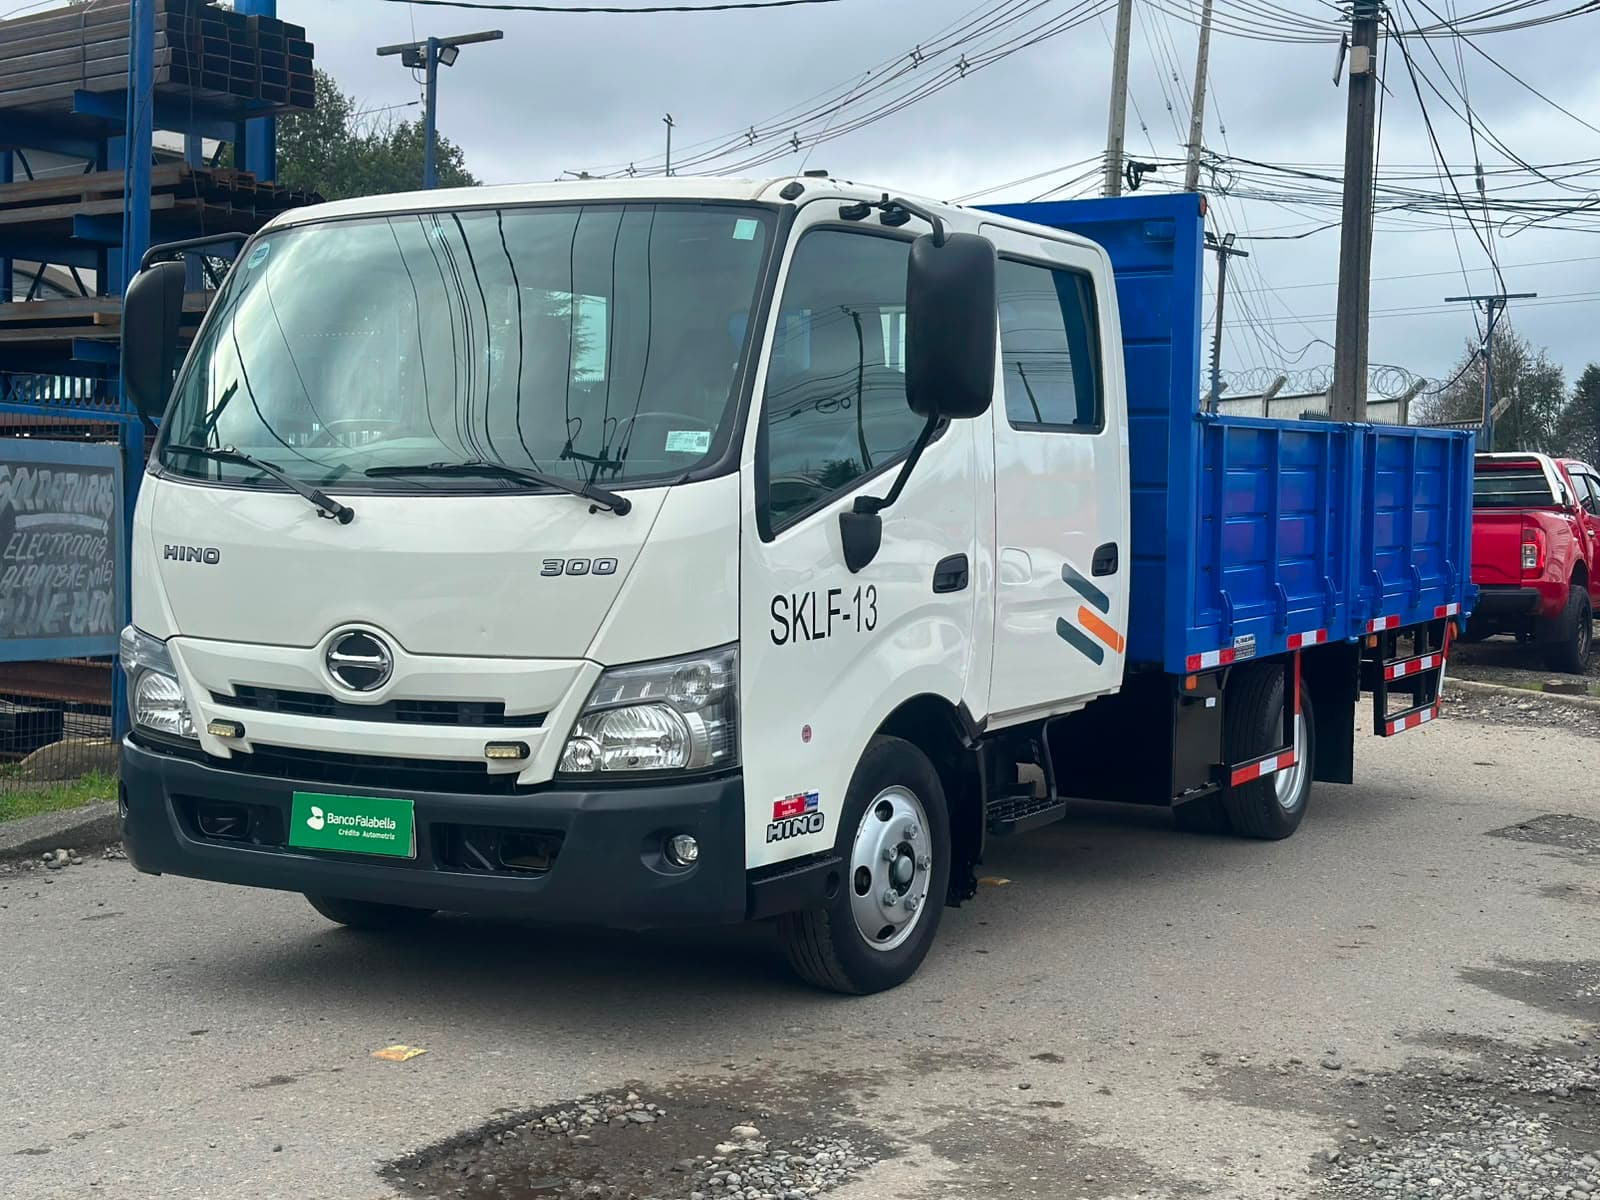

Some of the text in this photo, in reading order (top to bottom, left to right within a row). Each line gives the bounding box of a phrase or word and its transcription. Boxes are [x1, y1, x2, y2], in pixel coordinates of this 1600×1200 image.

[3, 532, 108, 561] ELECTRODOS
[163, 544, 220, 565] HINO
[540, 557, 618, 577] 300
[770, 584, 878, 645] SKLF-13
[327, 812, 396, 830] Banco Falabella
[766, 812, 825, 844] HINO
[338, 828, 360, 837] Crédito
